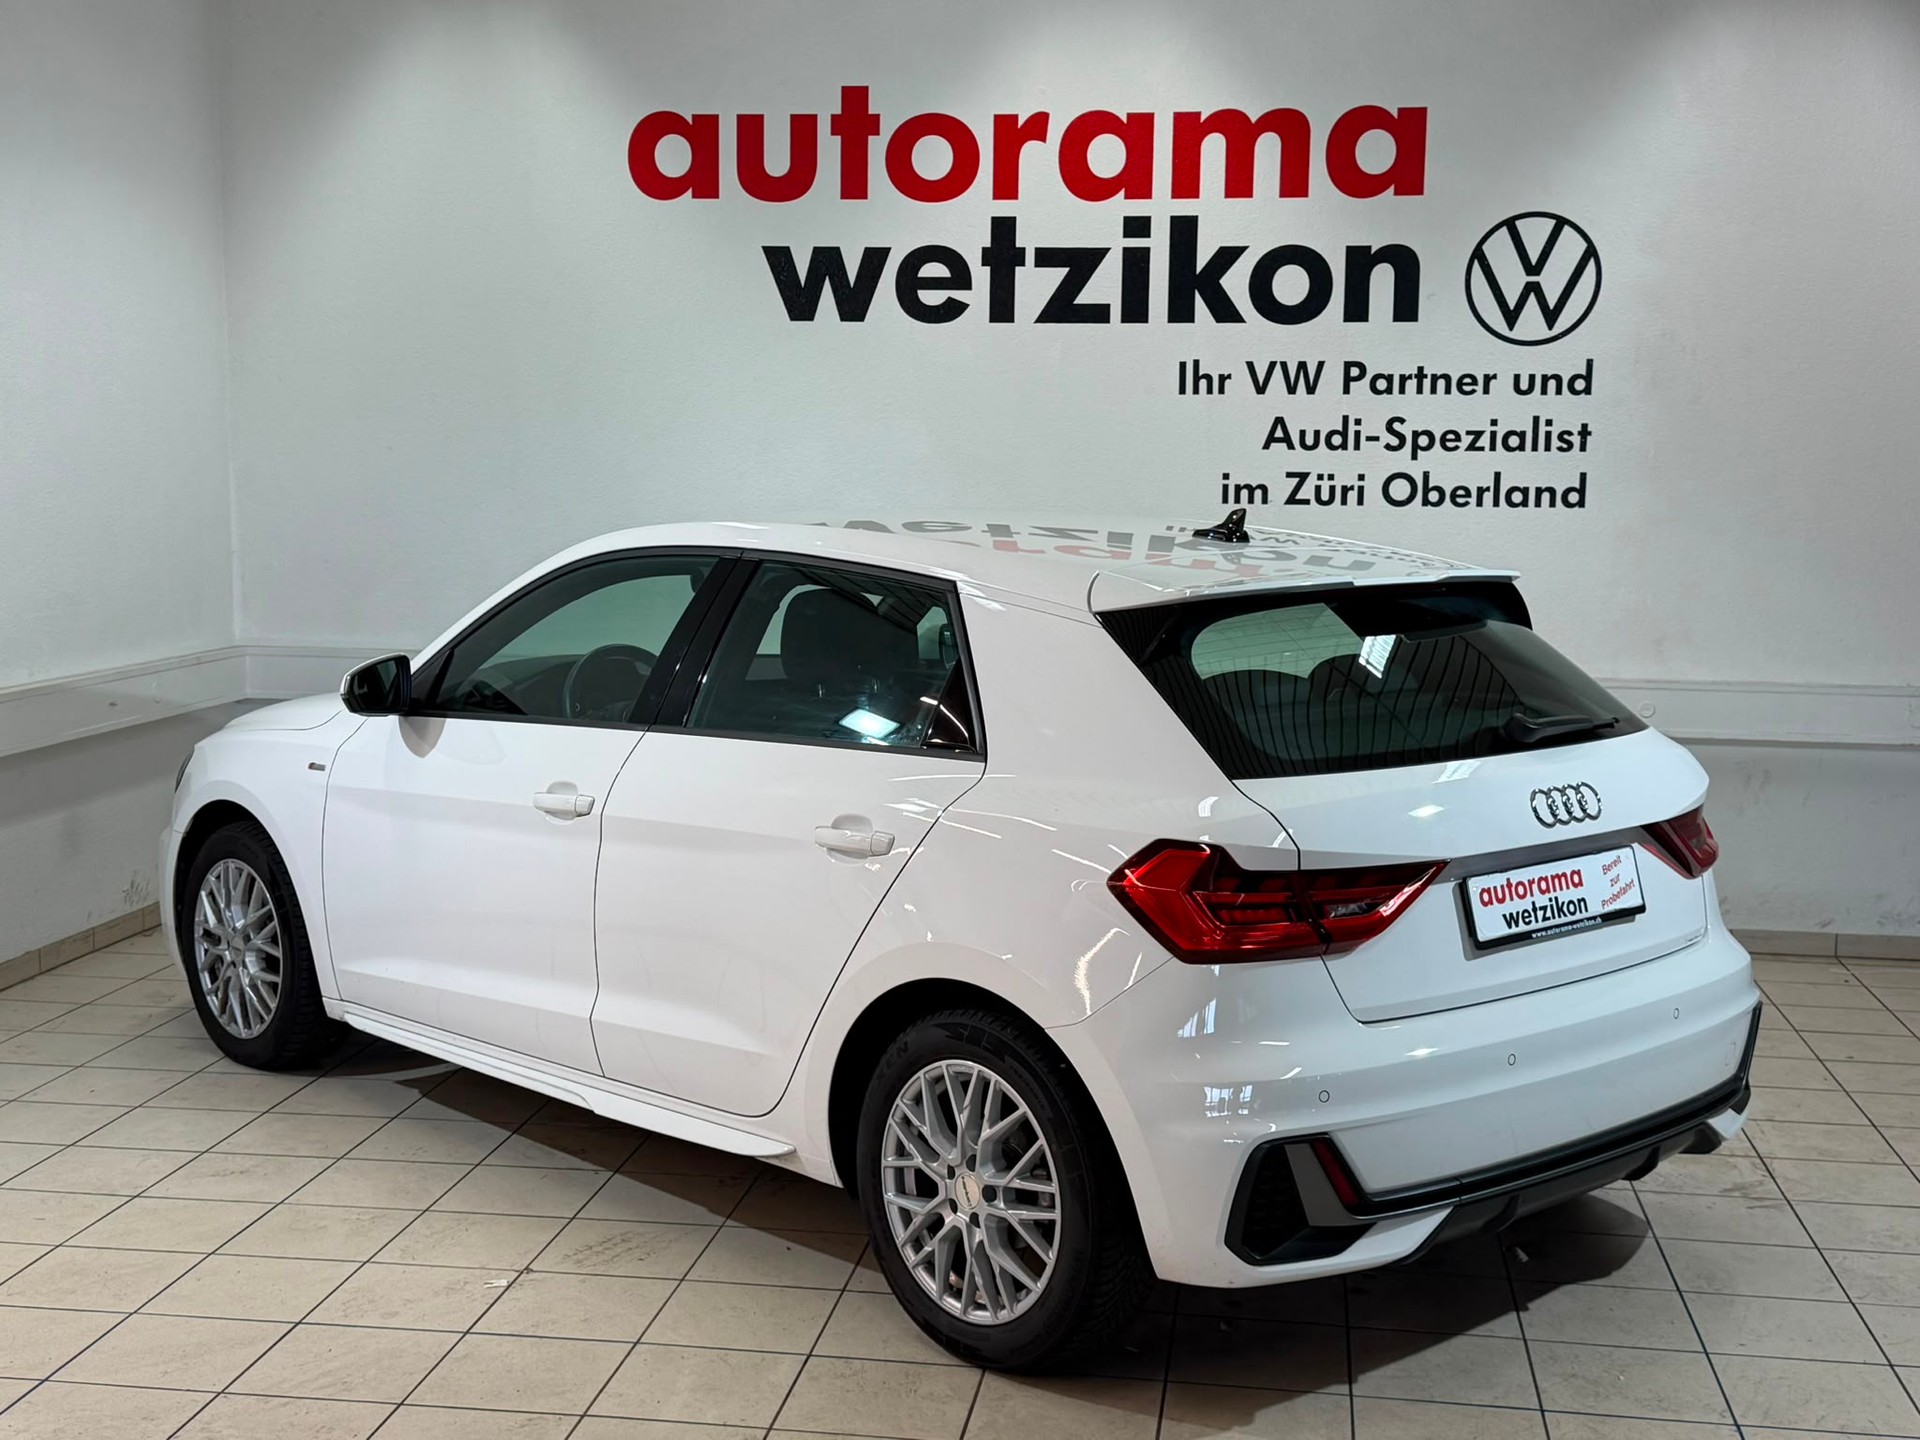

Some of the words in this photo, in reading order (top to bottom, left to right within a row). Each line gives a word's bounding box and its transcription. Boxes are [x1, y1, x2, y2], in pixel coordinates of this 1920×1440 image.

[628, 85, 1428, 203] autorama
[762, 214, 1421, 326] wetzikon
[1178, 358, 1232, 396] Ihr
[1245, 360, 1326, 396] VW
[1342, 360, 1498, 397] Partner
[1512, 358, 1594, 397] und
[1261, 414, 1593, 461] Audi-Spezialist
[1221, 472, 1269, 505] im
[1283, 471, 1366, 507] Züri
[1381, 470, 1588, 509] Oberland
[1601, 855, 1622, 876] Bereit
[1609, 873, 1621, 888] zur
[1479, 868, 1584, 908] autorama
[1601, 878, 1636, 910] Probefahrt
[1502, 896, 1589, 930] wetzikon
